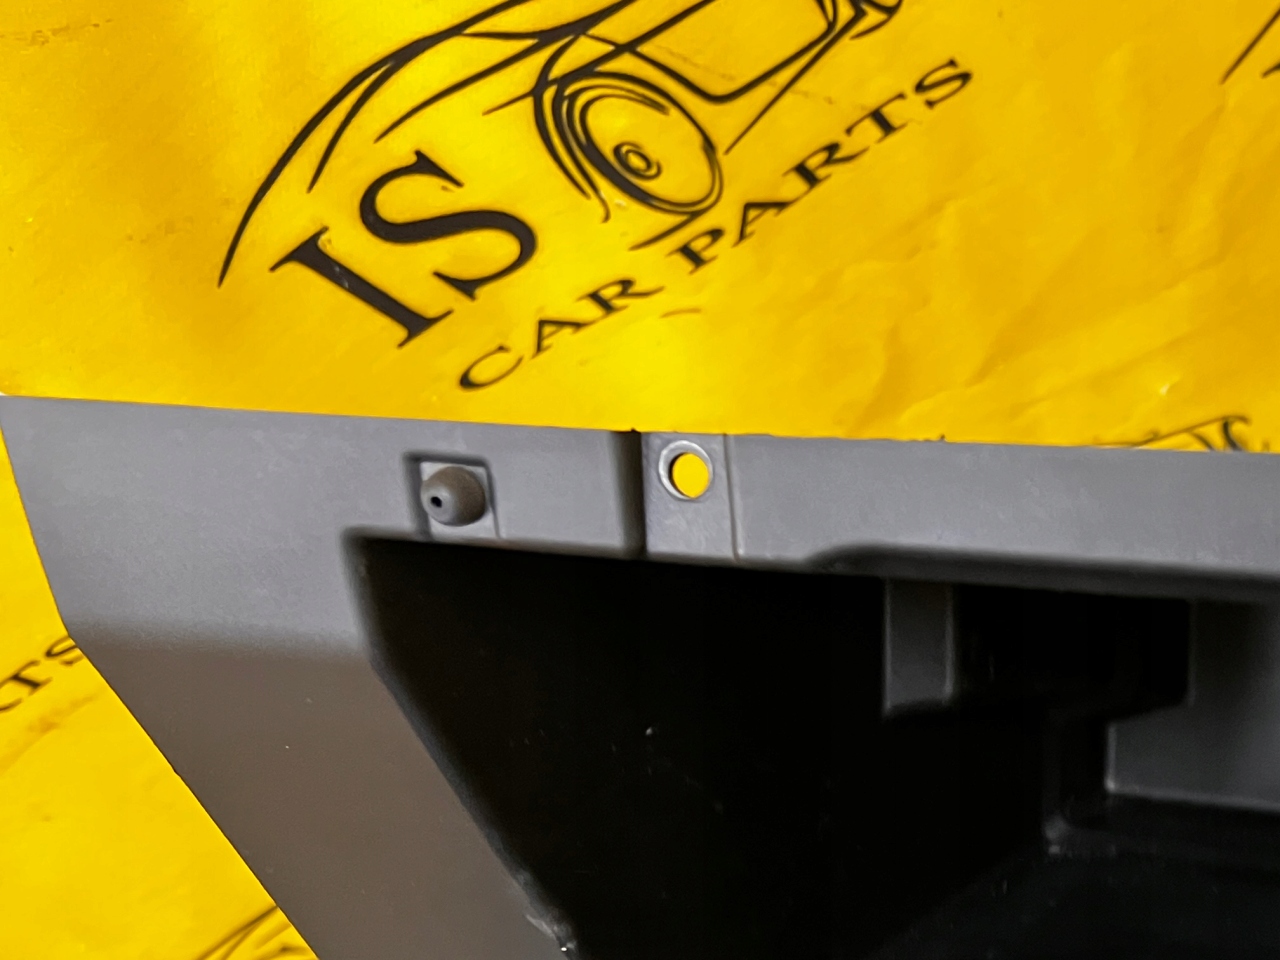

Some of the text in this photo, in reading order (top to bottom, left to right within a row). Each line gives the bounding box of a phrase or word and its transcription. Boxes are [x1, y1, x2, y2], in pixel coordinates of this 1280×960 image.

[269, 149, 537, 349] IS
[458, 58, 973, 392] CAR PARTS
